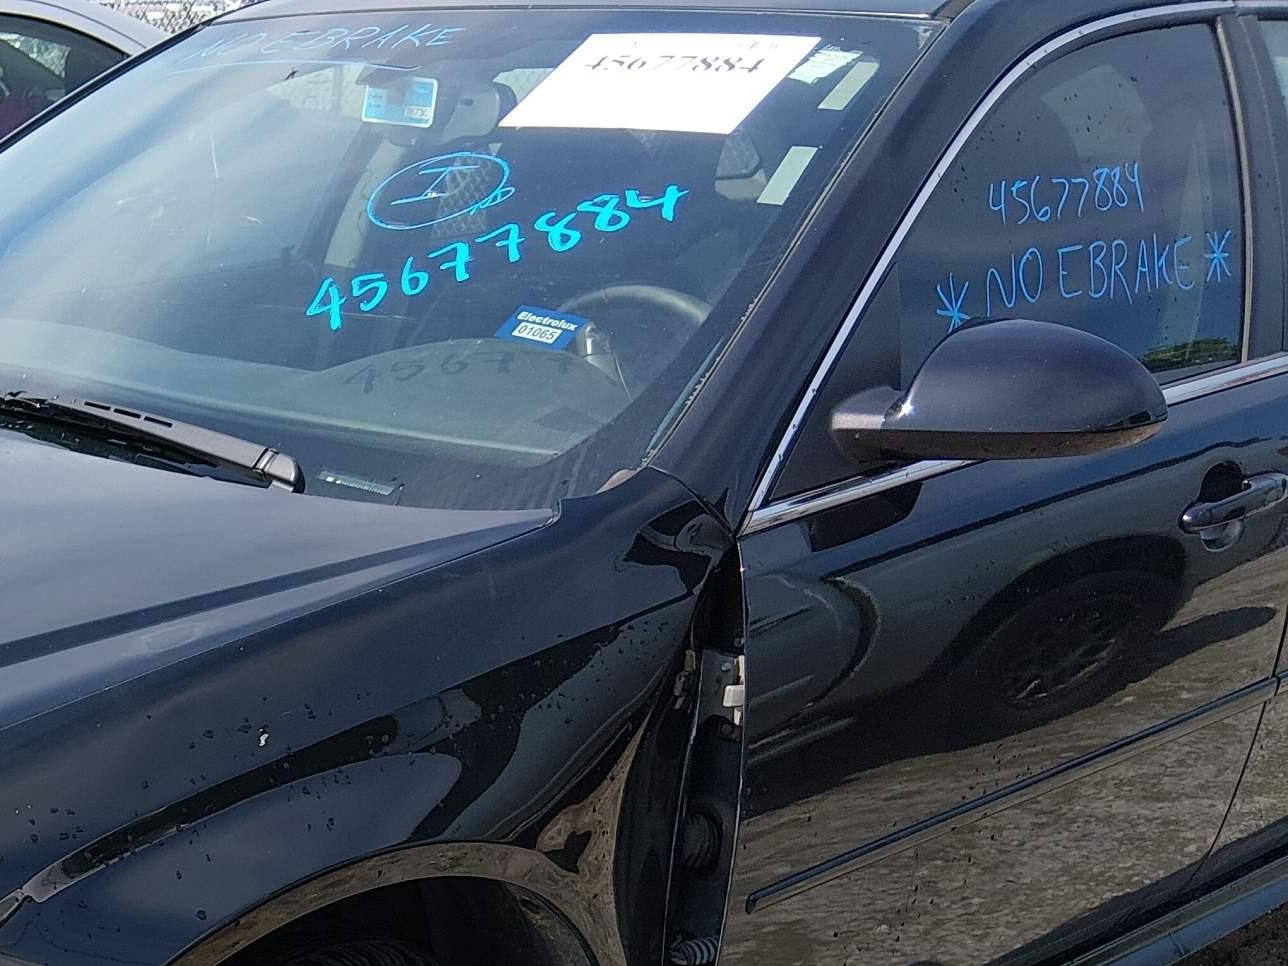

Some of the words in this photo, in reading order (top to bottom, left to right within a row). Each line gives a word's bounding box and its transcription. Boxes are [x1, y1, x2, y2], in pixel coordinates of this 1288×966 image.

[261, 23, 467, 55] EBRAKE
[988, 161, 1144, 225] 45677884
[306, 184, 689, 331] 45677884
[986, 246, 1044, 318] NO
[1058, 232, 1195, 304] EBRAKE
[516, 310, 580, 332] Electrolux
[517, 323, 558, 342] 01065
